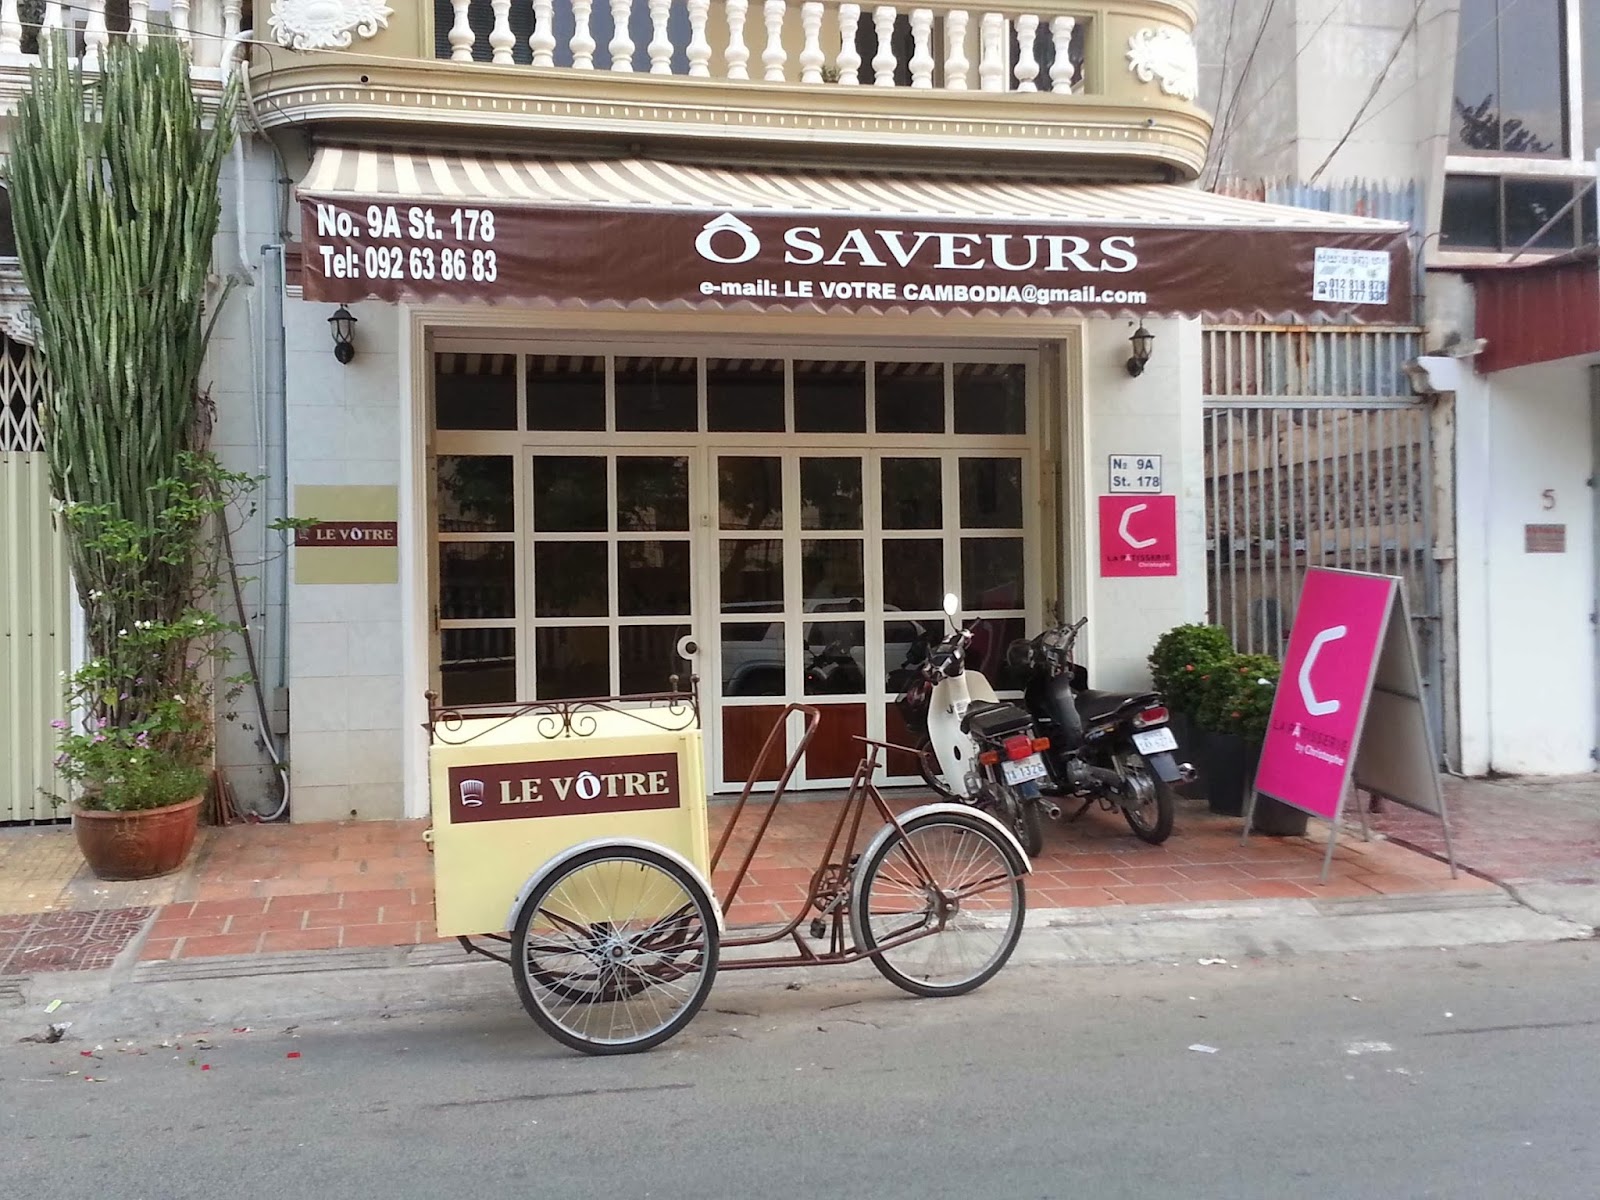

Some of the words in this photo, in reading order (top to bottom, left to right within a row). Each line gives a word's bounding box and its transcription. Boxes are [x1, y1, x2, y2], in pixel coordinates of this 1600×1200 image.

[317, 204, 360, 237] No.
[366, 205, 402, 239] 9A
[408, 207, 443, 240] St.
[450, 208, 496, 242] 178
[694, 212, 761, 264] Ô
[782, 226, 1139, 273] SAVEURS
[319, 245, 359, 278] Tel:
[365, 246, 404, 279] 092
[409, 247, 435, 280] 63
[440, 248, 466, 281] 86
[471, 249, 497, 282] 83
[699, 279, 778, 297] e-mail:
[784, 281, 813, 298] LE
[823, 281, 897, 300] VOTRE
[902, 282, 1147, 305] CAMBODIA@gmail.com
[1329, 278, 1345, 289] 012
[1136, 459, 1154, 470] 9A
[1113, 476, 1131, 487] St.
[1136, 476, 1160, 487] 178
[1542, 488, 1556, 511] 5
[316, 528, 336, 540] LE
[499, 778, 544, 805] LE
[549, 769, 671, 802] VÔTRE
